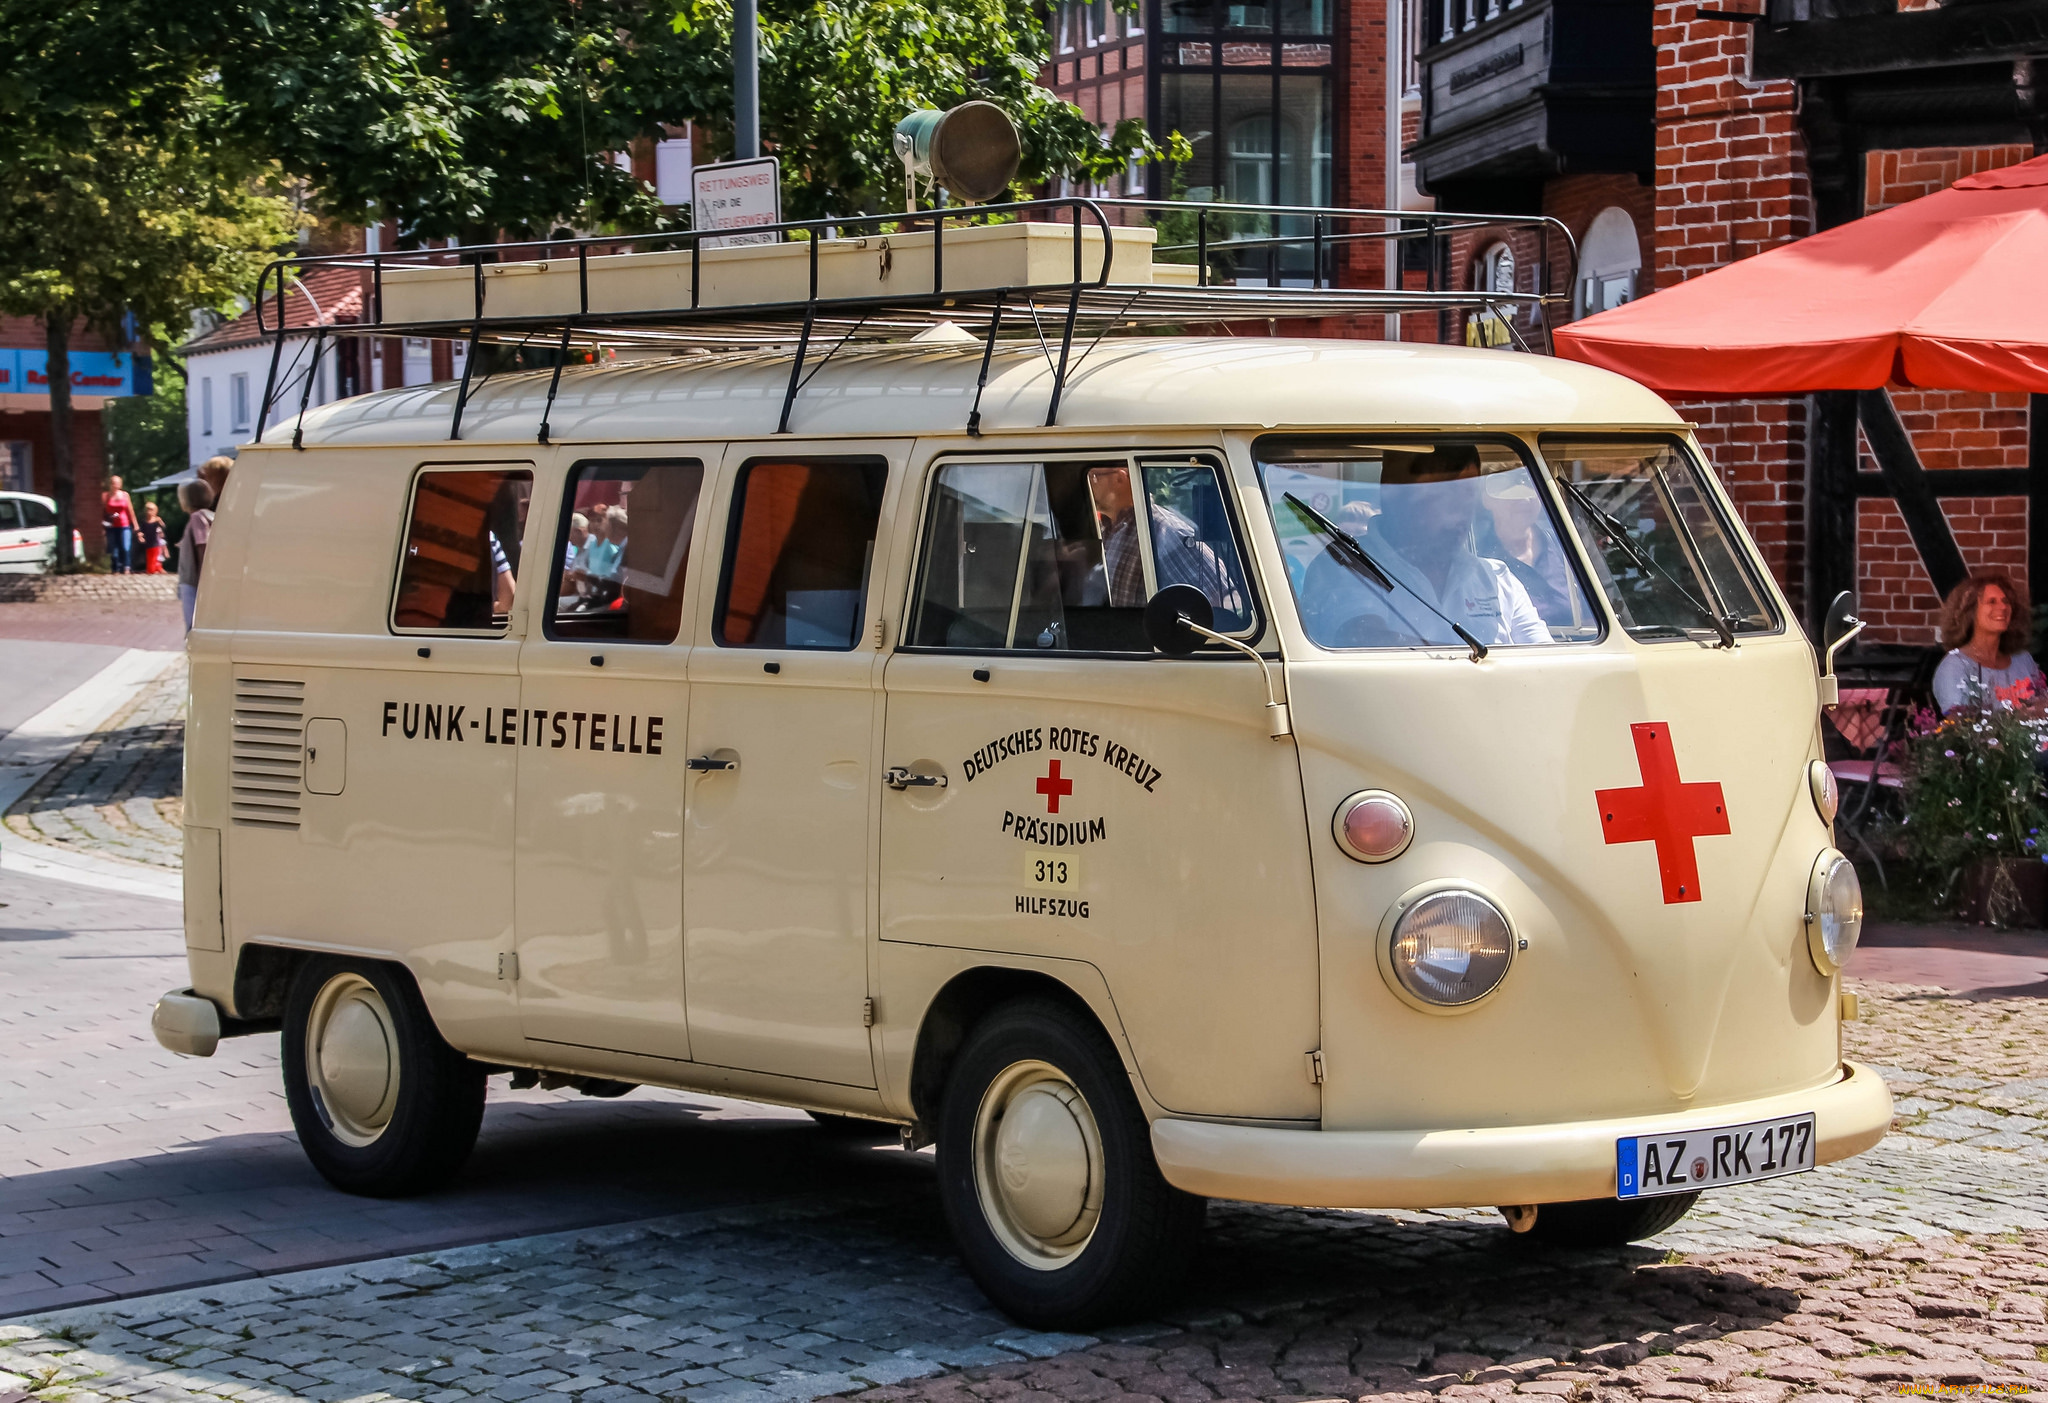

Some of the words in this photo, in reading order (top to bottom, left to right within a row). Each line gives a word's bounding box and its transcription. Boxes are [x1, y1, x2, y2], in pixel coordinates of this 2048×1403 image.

[699, 173, 770, 193] RETTUNGSWEG
[382, 701, 664, 755] FUNK-LEITSTELLE
[963, 727, 1043, 783] DEUTSCHES
[1050, 727, 1100, 757] ROTES
[1103, 740, 1162, 793] KREUZ
[1002, 810, 1106, 846] PRÄSIDIUM
[1035, 859, 1068, 884] 313
[1015, 895, 1090, 918] HILFSZUG
[1623, 1173, 1632, 1187] D
[1642, 1140, 1687, 1187] AZ
[1713, 1132, 1753, 1179] RK
[1761, 1121, 1812, 1171] 177
